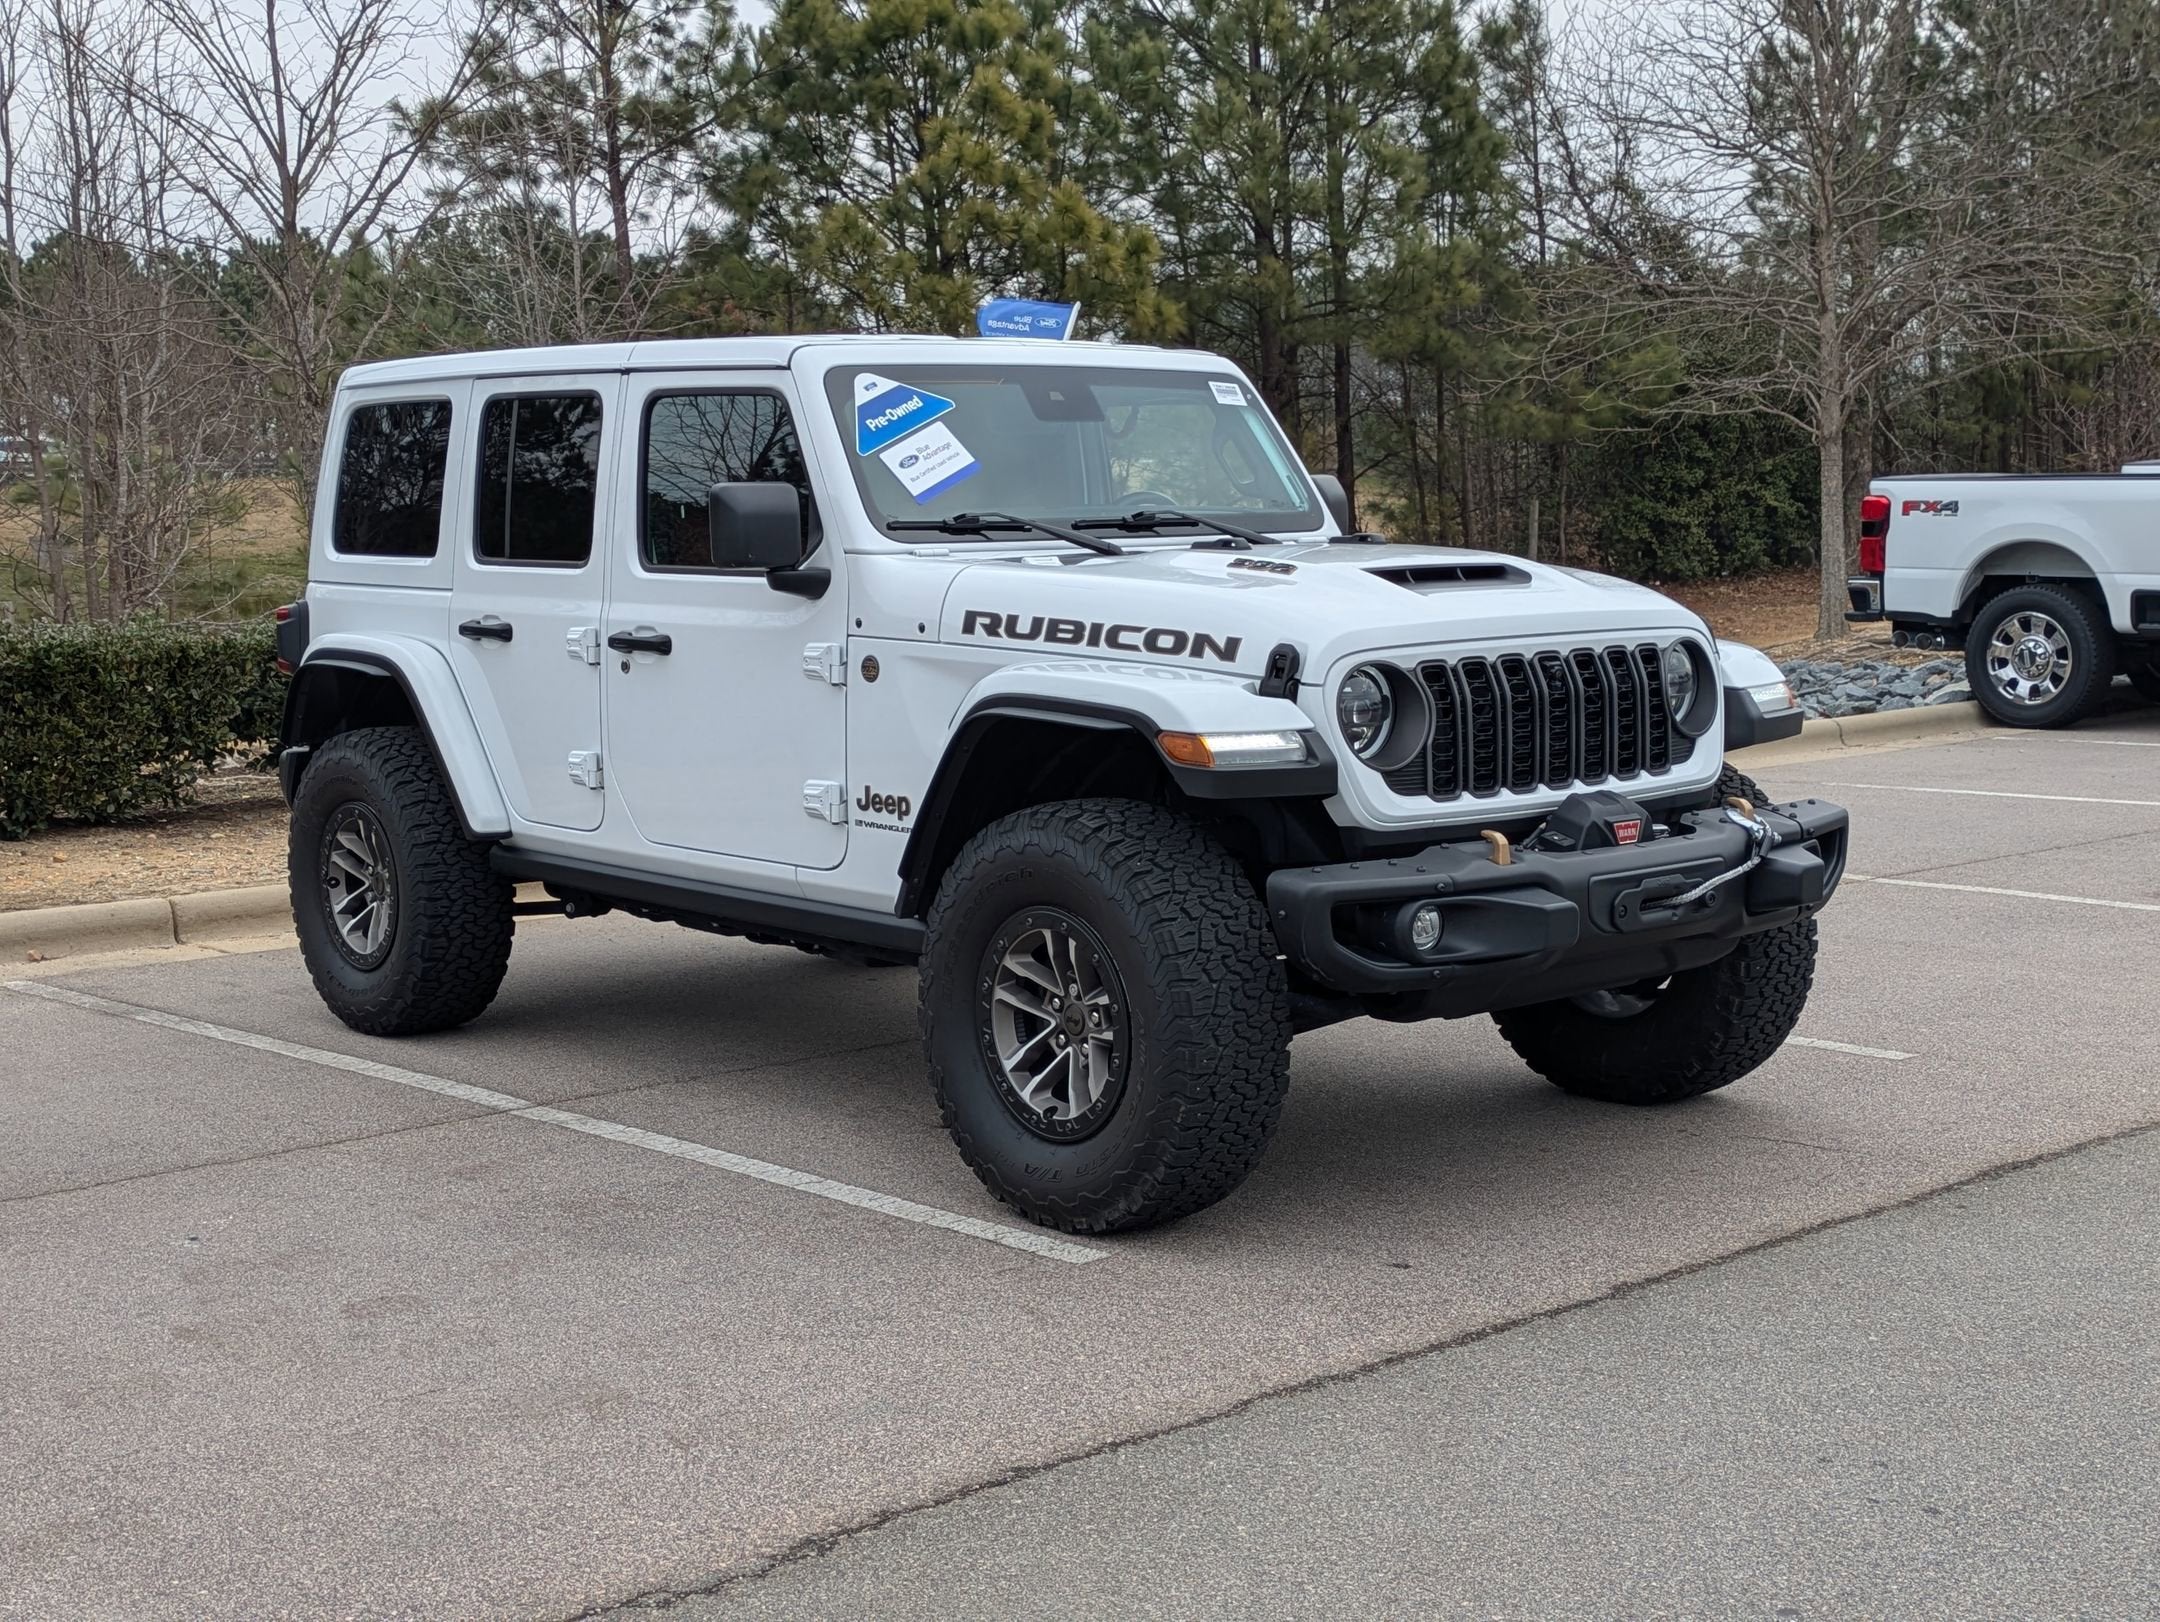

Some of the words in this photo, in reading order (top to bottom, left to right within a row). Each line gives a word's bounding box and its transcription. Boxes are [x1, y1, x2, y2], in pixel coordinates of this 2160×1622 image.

[865, 395, 924, 432] Pre-Owned
[915, 444, 930, 455] Blue
[922, 442, 952, 462] Advantage
[1902, 500, 1960, 516] FX4
[961, 609, 1242, 663] RUBICON
[856, 785, 911, 821] Jeep
[1618, 827, 1637, 838] WARN
